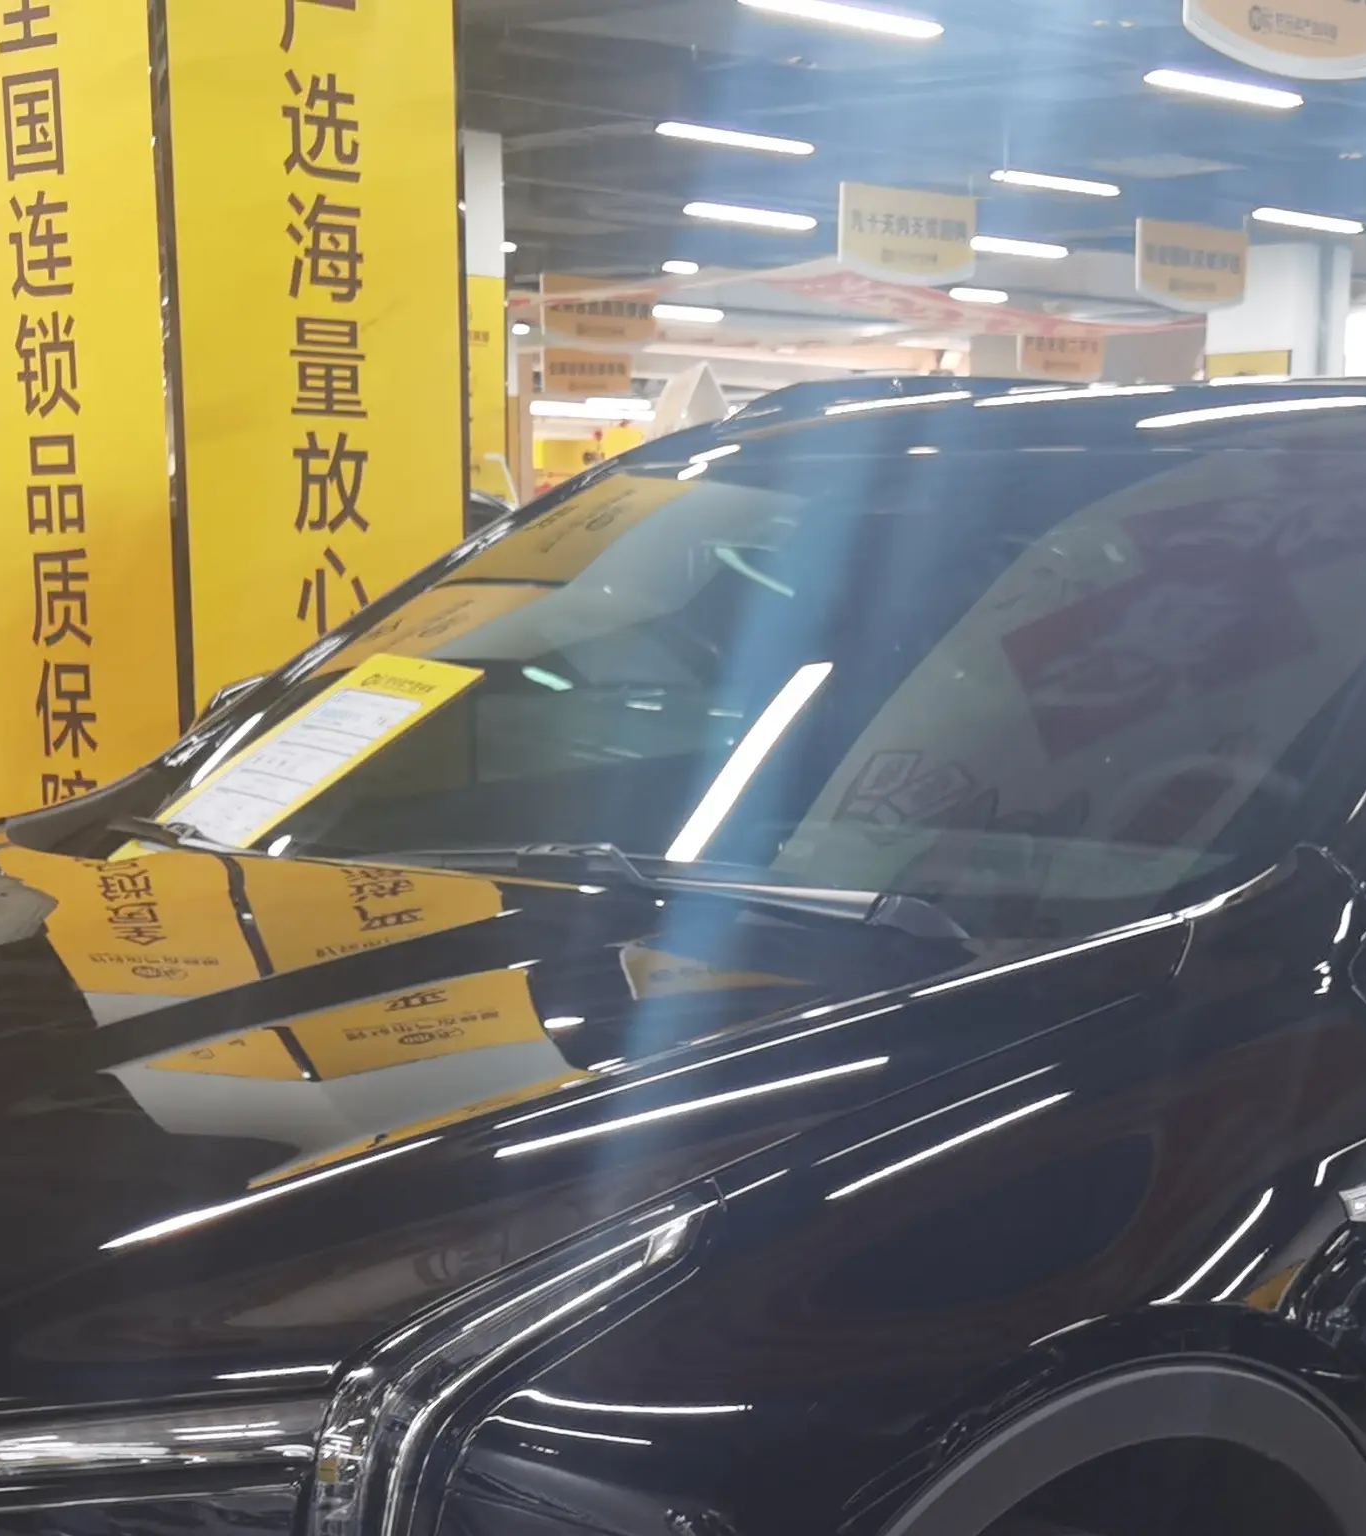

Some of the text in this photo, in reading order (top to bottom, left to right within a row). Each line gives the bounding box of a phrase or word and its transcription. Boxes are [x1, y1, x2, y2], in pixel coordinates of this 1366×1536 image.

[279, 0, 370, 635] 选海量放心
